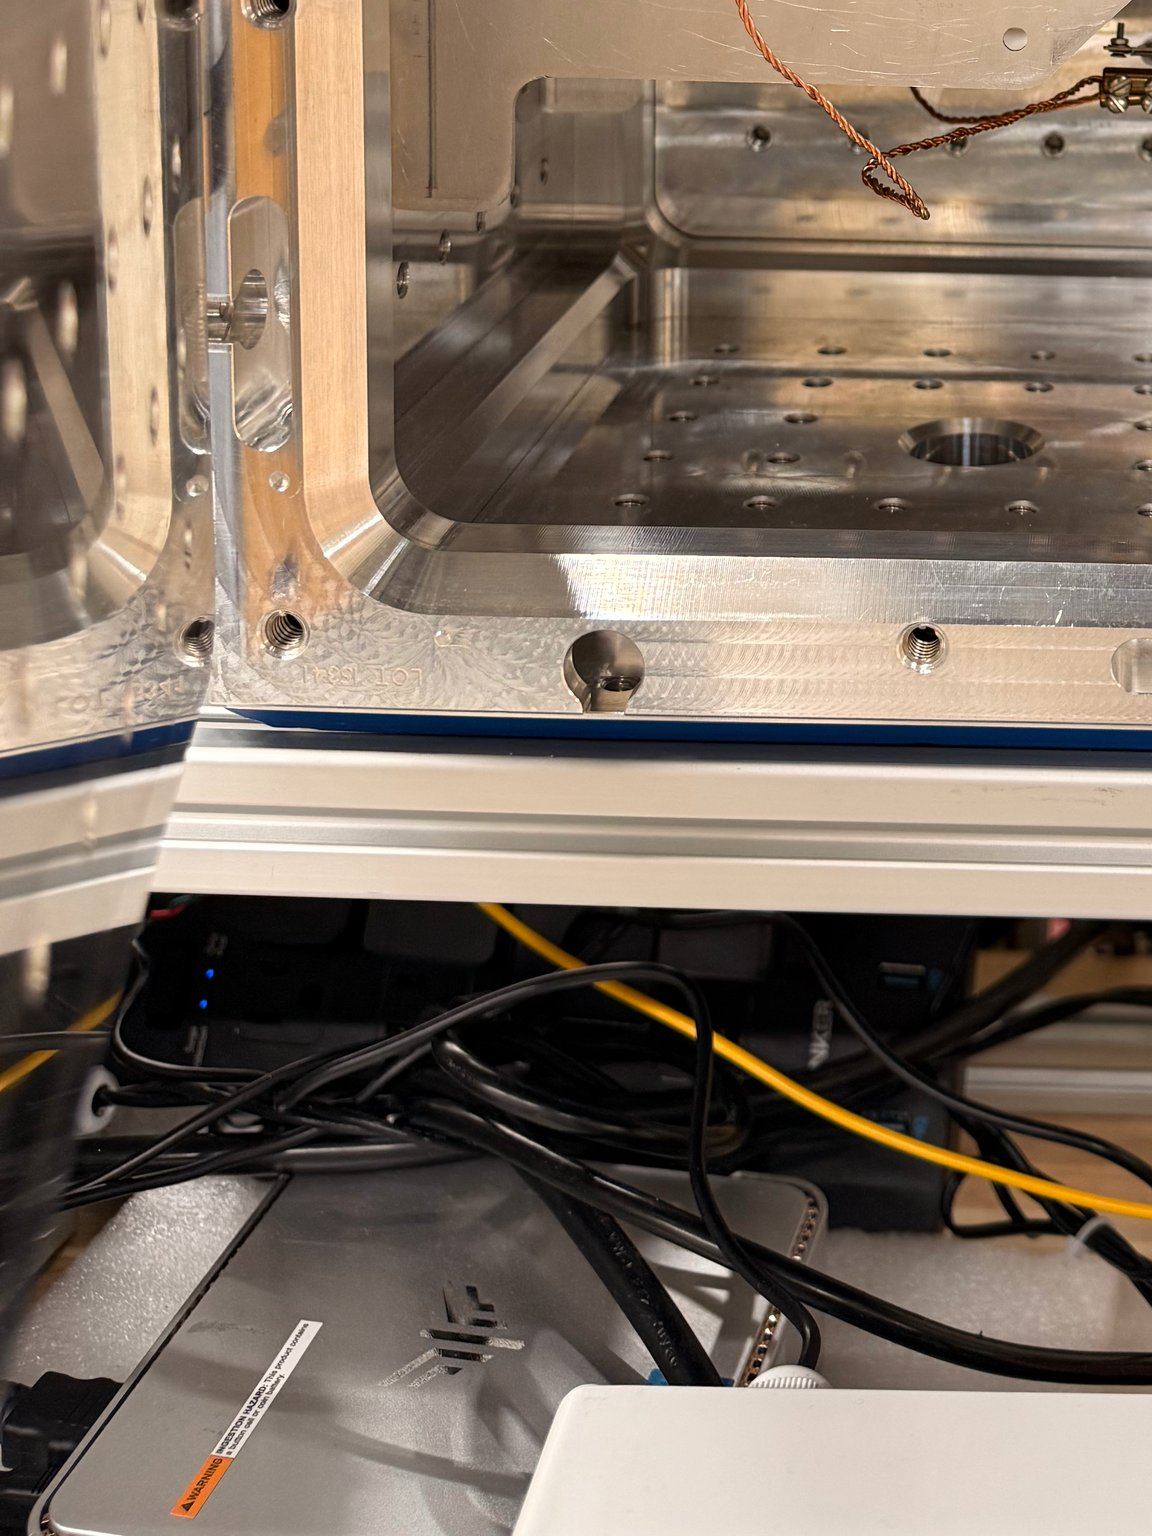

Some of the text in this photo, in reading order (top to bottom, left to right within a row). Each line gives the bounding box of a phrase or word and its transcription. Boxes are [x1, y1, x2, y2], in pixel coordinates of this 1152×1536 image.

[216, 1323, 310, 1454] INGESTION HAZARD: This product contains
[186, 1457, 223, 1501] WARNING
